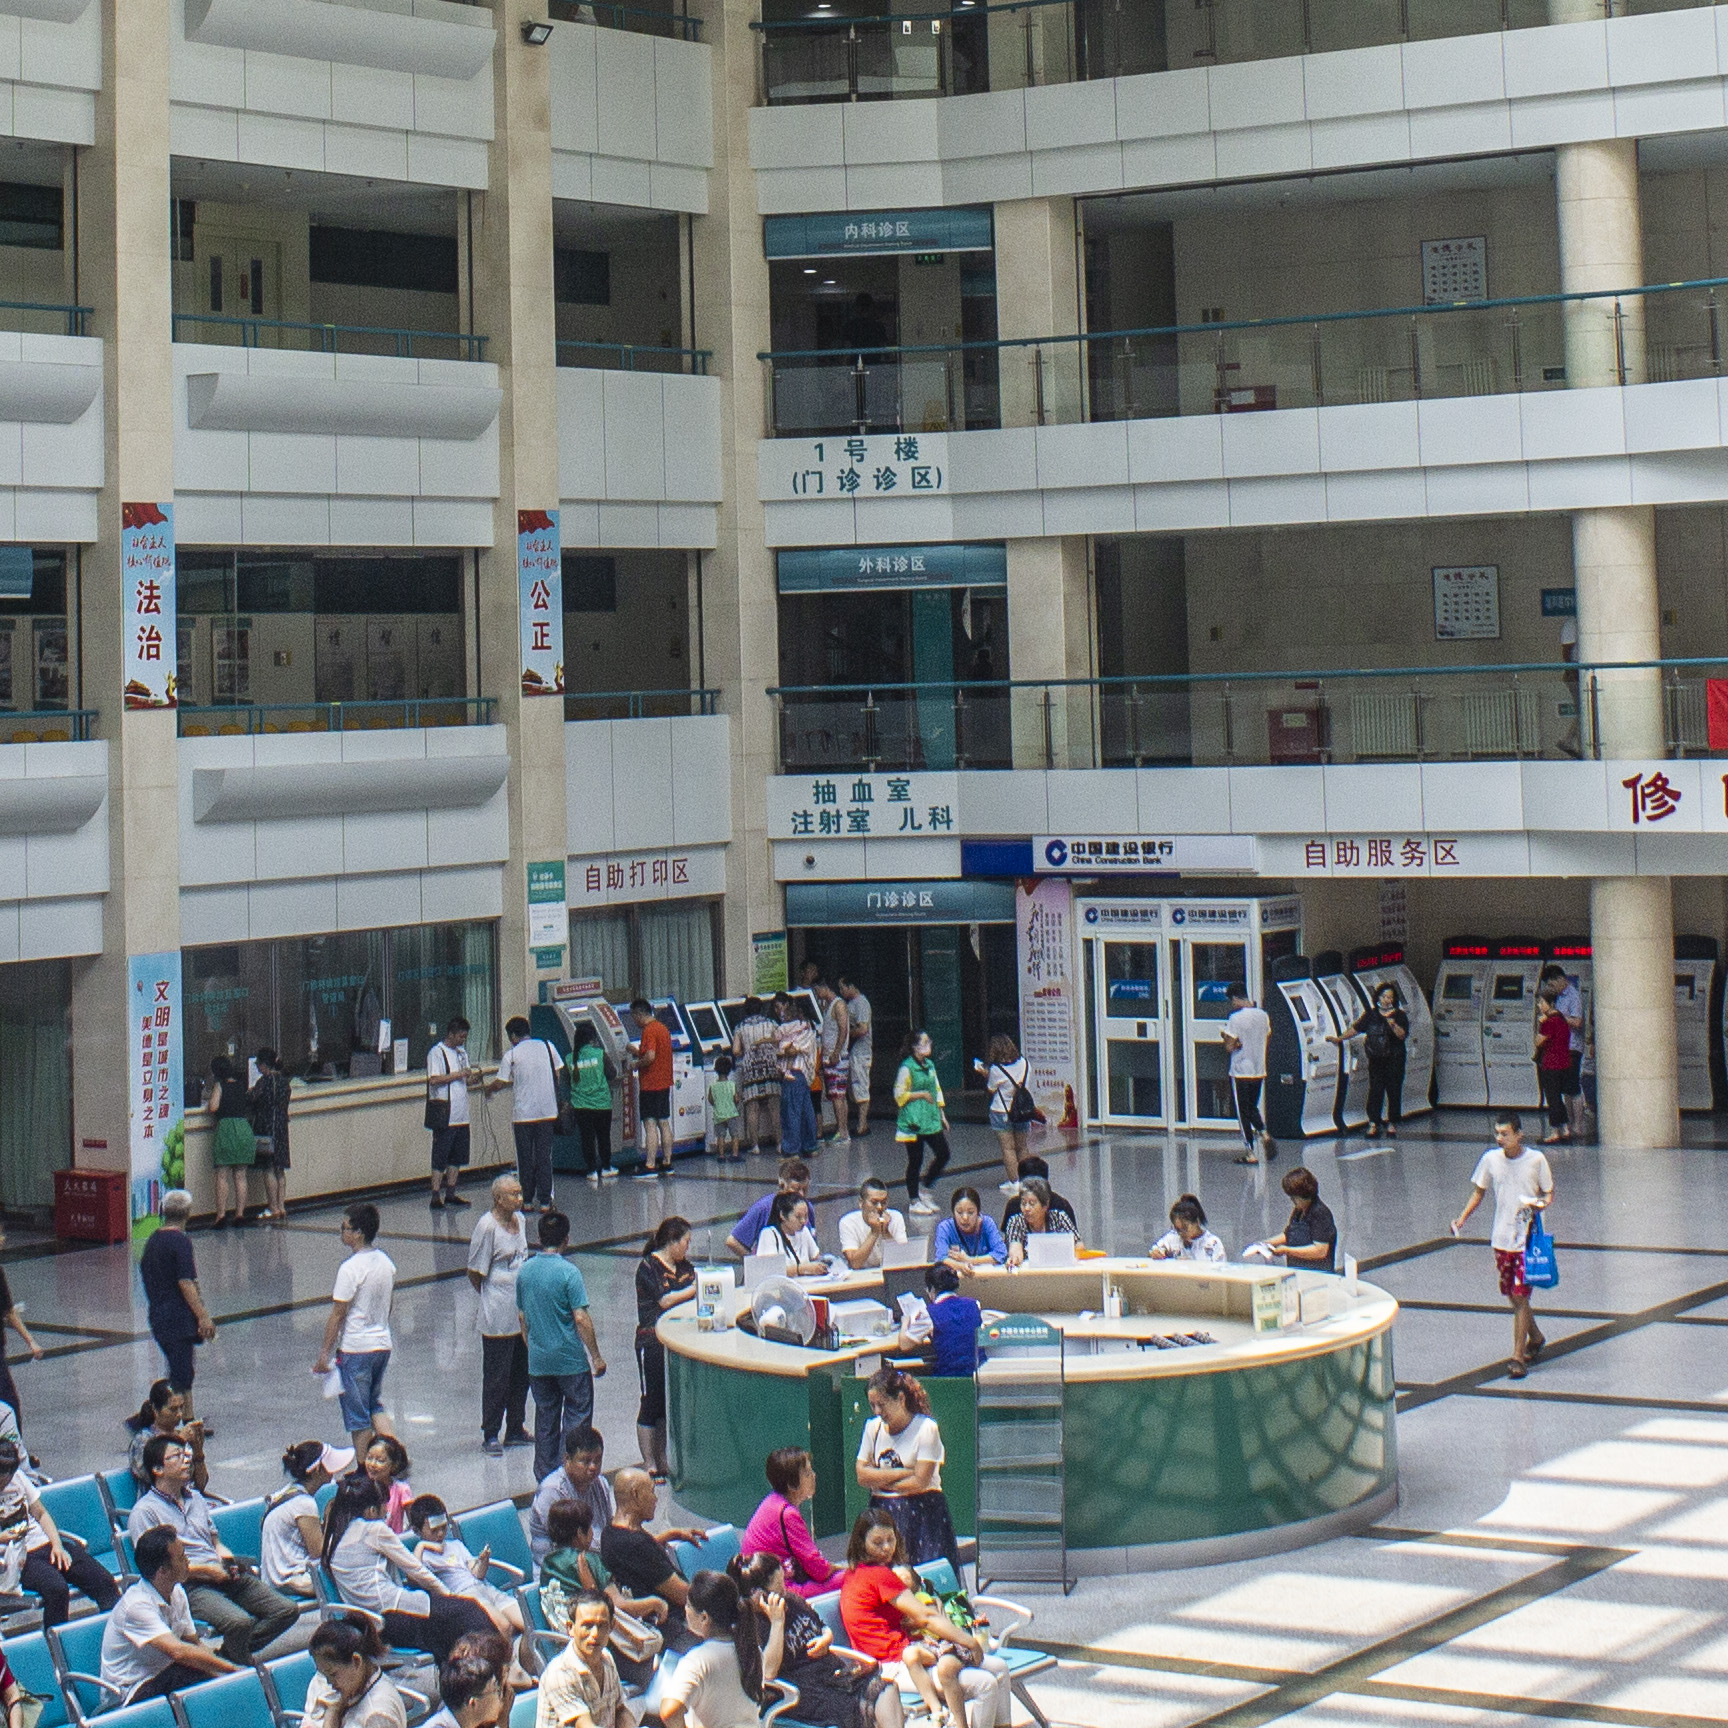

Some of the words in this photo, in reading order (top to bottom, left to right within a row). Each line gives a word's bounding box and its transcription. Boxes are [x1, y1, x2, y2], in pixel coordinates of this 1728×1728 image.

[845, 221, 911, 239] 内科诊区
[813, 437, 922, 464] 1号楼
[859, 556, 926, 573] 外科诊区
[136, 579, 163, 661] 法治
[530, 580, 552, 651] 公正
[812, 778, 913, 806] 抽血室
[790, 808, 872, 836] 注射室
[897, 805, 954, 832] 儿科
[1071, 841, 1173, 855] 中国建设银行
[1304, 837, 1462, 869] 自助服务区
[586, 858, 689, 892] 自助打印区
[867, 891, 933, 908] 门诊诊区
[154, 980, 170, 1119] 文明是城市之魂
[141, 1016, 154, 1139] 美德是立身之本
